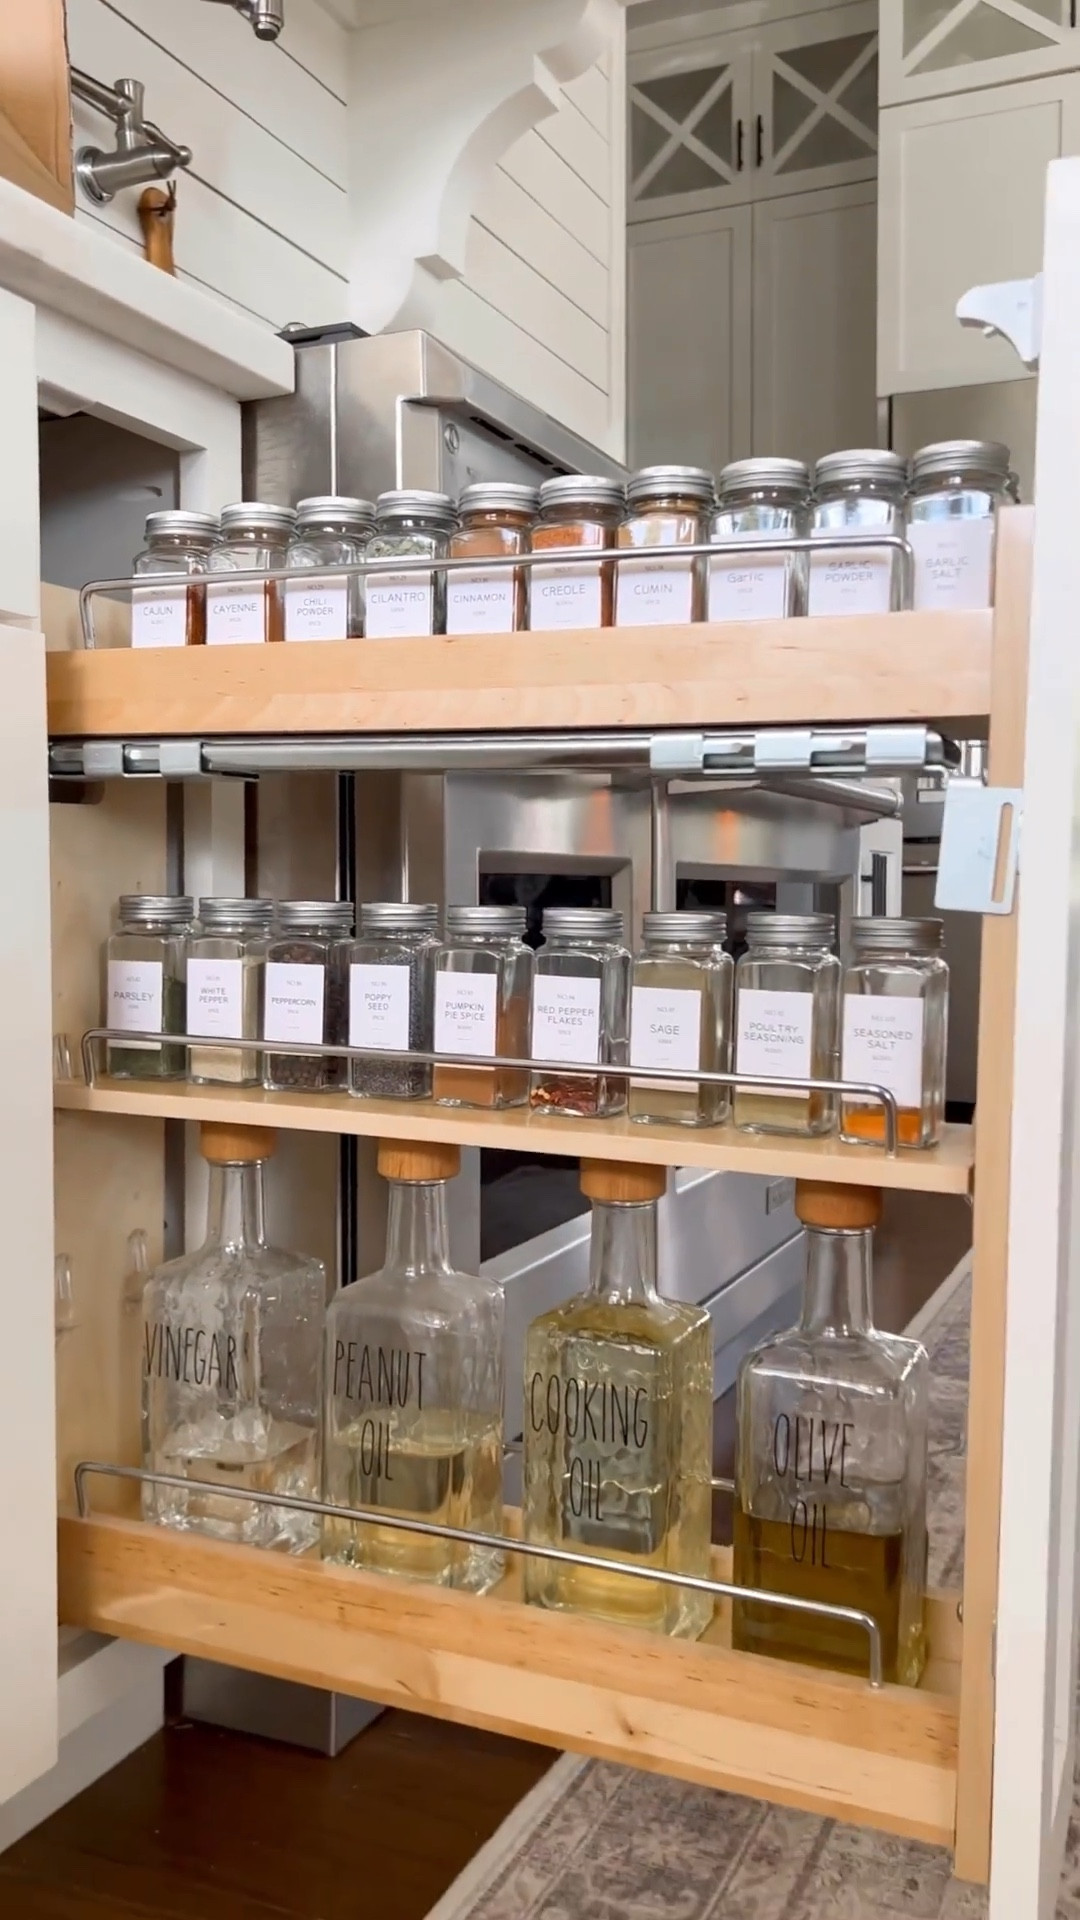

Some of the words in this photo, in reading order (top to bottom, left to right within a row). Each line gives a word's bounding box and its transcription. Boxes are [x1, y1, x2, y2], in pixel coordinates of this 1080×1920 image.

[828, 560, 871, 572] GARLIC
[925, 556, 969, 568] GARLIC
[727, 573, 764, 583] Garlic
[825, 571, 873, 582] POWDER
[931, 568, 962, 580] SALT
[542, 584, 586, 597] CREOLE
[634, 584, 673, 595] CUMIN
[303, 598, 327, 606] CHILI
[371, 592, 426, 604] CILANTRO
[453, 593, 506, 604] CINNAMON
[143, 606, 173, 616] CAJUN
[213, 603, 258, 614] CAYENNE
[297, 607, 334, 616] POWDER
[113, 991, 154, 1002] PARSLEY
[200, 987, 226, 996] WHITE
[199, 996, 229, 1004] PEPPER
[271, 997, 316, 1006] PEPPERCORN
[364, 993, 392, 1002] POPPY
[368, 1002, 390, 1011] SEED
[445, 1001, 485, 1012] PUMPKIN
[537, 1005, 555, 1014] RED
[558, 1007, 595, 1017] PEPPER
[444, 1011, 458, 1020] PIE
[460, 1012, 486, 1022] SPICE
[547, 1016, 583, 1026] FLAKES
[650, 1024, 680, 1036] SAGE
[750, 1022, 799, 1033] POULTRY
[744, 1032, 804, 1044] SEASONING
[854, 1028, 913, 1040] SEASONED
[867, 1040, 897, 1050] SALT
[145, 1321, 238, 1390] VINEGAR
[333, 1339, 427, 1410] PEANUT
[530, 1372, 648, 1448] COOKING
[361, 1419, 394, 1481] OIL
[774, 1413, 854, 1488] OLIVE
[569, 1456, 604, 1521] OIL
[790, 1500, 830, 1568] OIL
